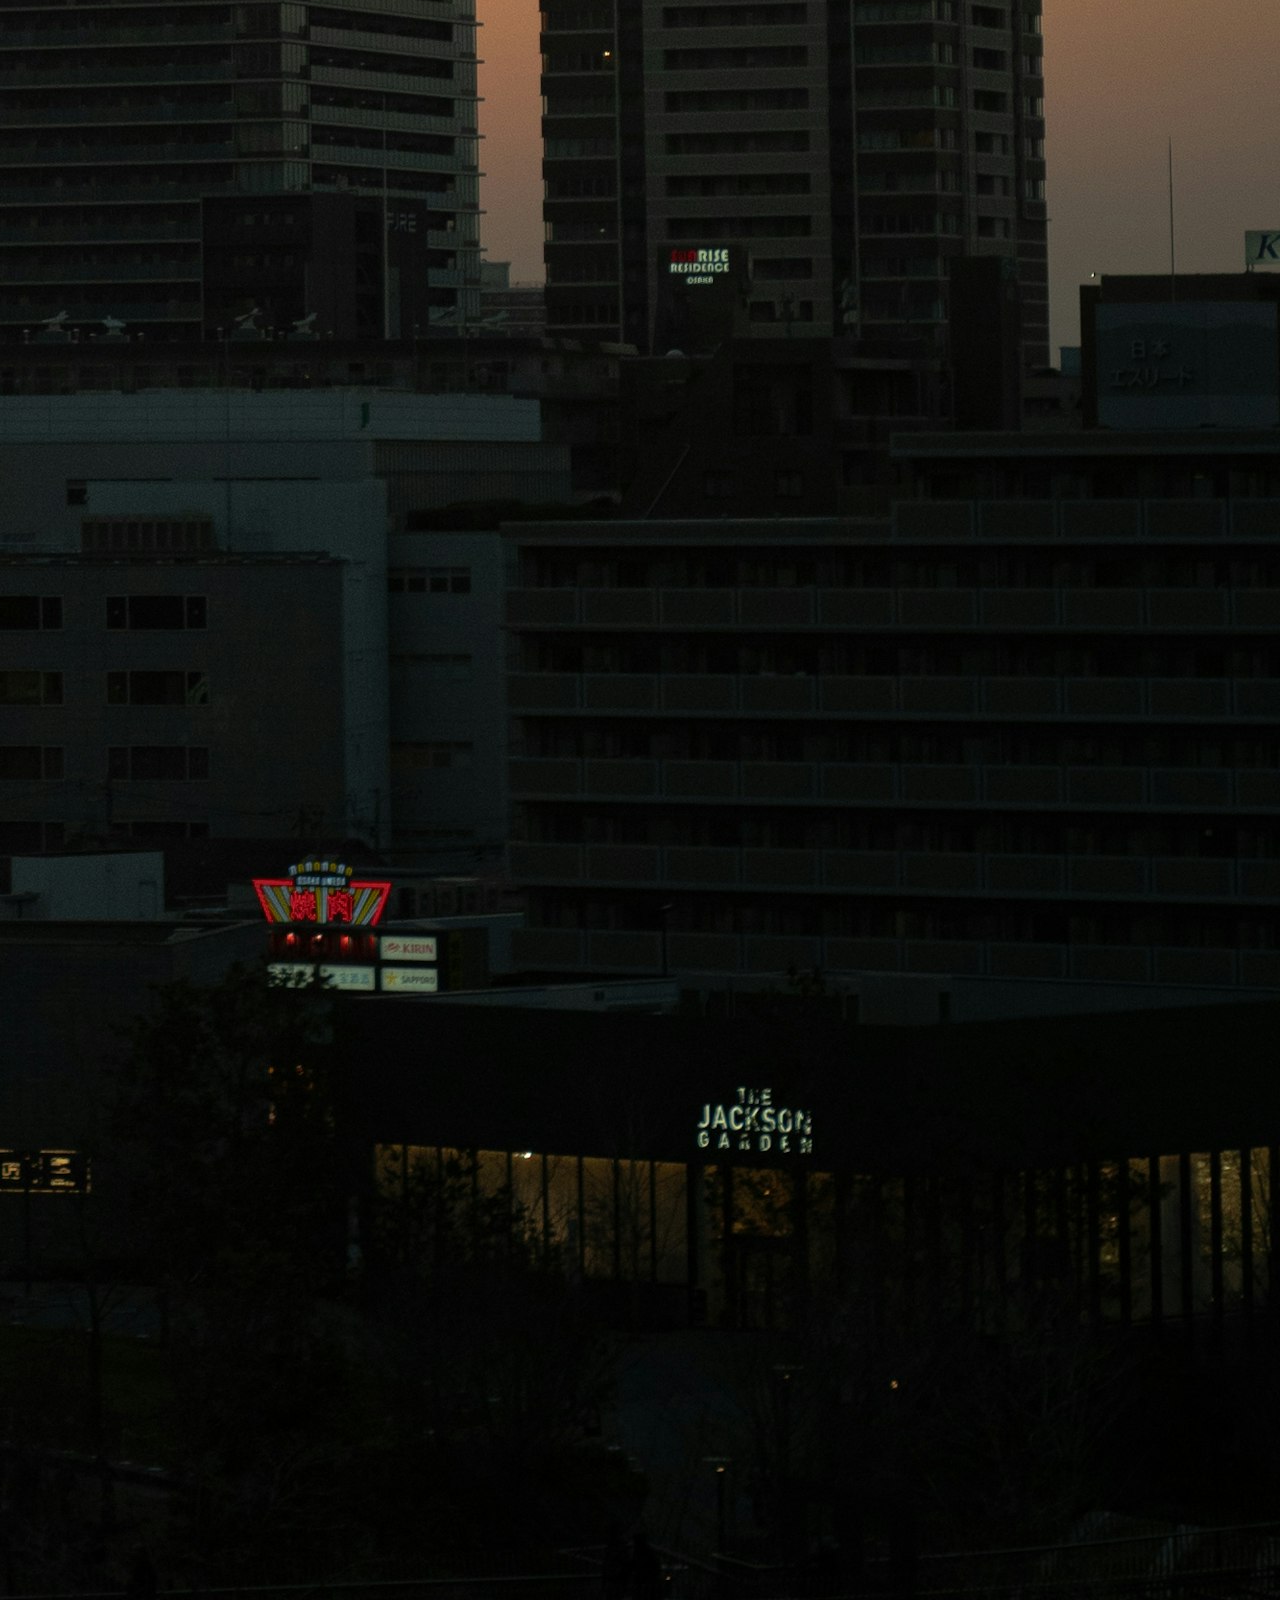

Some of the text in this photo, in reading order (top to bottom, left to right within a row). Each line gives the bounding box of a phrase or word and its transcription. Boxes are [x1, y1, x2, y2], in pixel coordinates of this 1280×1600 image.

[670, 262, 730, 273] RESIDENCE
[687, 275, 714, 285] OSAKA
[1131, 337, 1171, 359] 日本
[1109, 365, 1194, 388] エスリード
[290, 890, 353, 921] 焼肉
[402, 943, 434, 954] KIRIN
[401, 975, 436, 984] SAPPORO
[736, 1086, 773, 1105] THE
[697, 1103, 812, 1135] JACKSON
[697, 1129, 813, 1154] GARDEN
